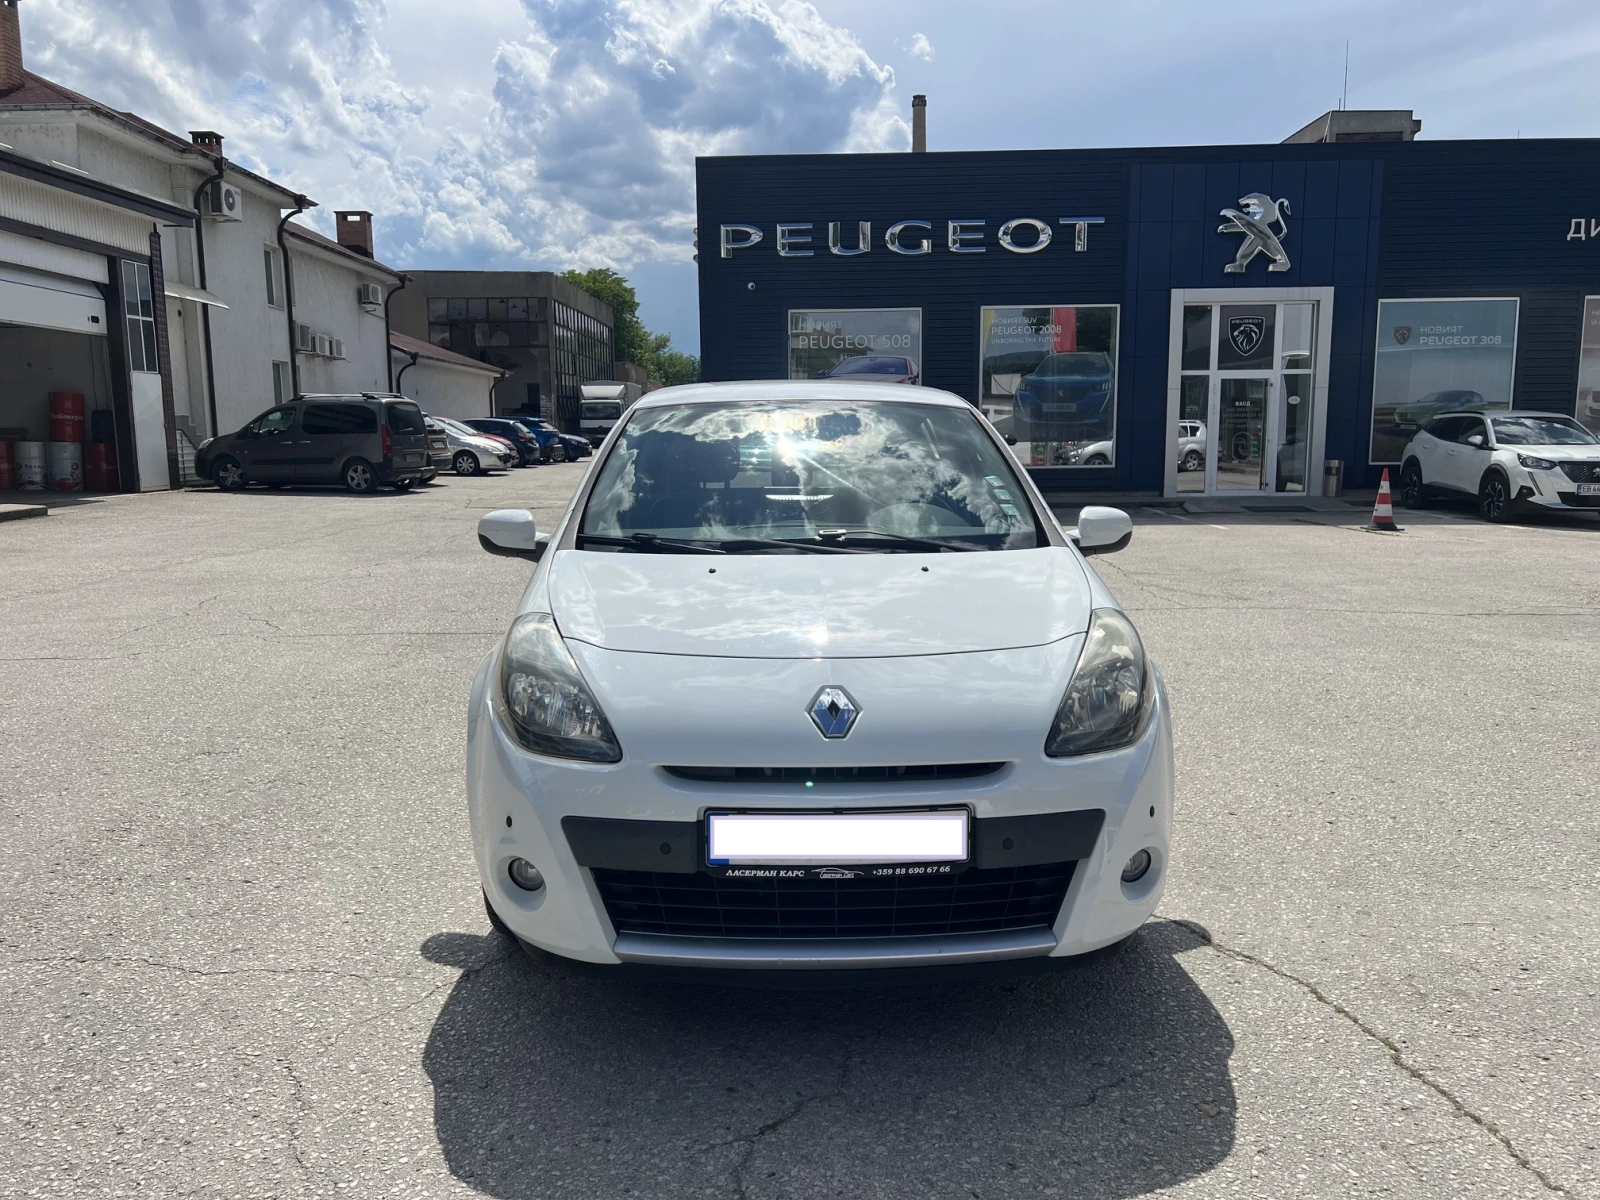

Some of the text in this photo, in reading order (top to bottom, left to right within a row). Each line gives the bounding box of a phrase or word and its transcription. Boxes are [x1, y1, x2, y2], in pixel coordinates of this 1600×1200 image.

[720, 217, 1105, 258] PEUGEOT
[991, 325, 1062, 335] PEUGEOT 2008
[1420, 325, 1463, 334] НОВИЯТ
[799, 334, 911, 349] PEUGEOT 508
[1420, 335, 1502, 345] PEUGEOT 308
[726, 869, 777, 877] ЛАСЕРМАН
[872, 868, 893, 876] +359
[895, 867, 906, 875] 88
